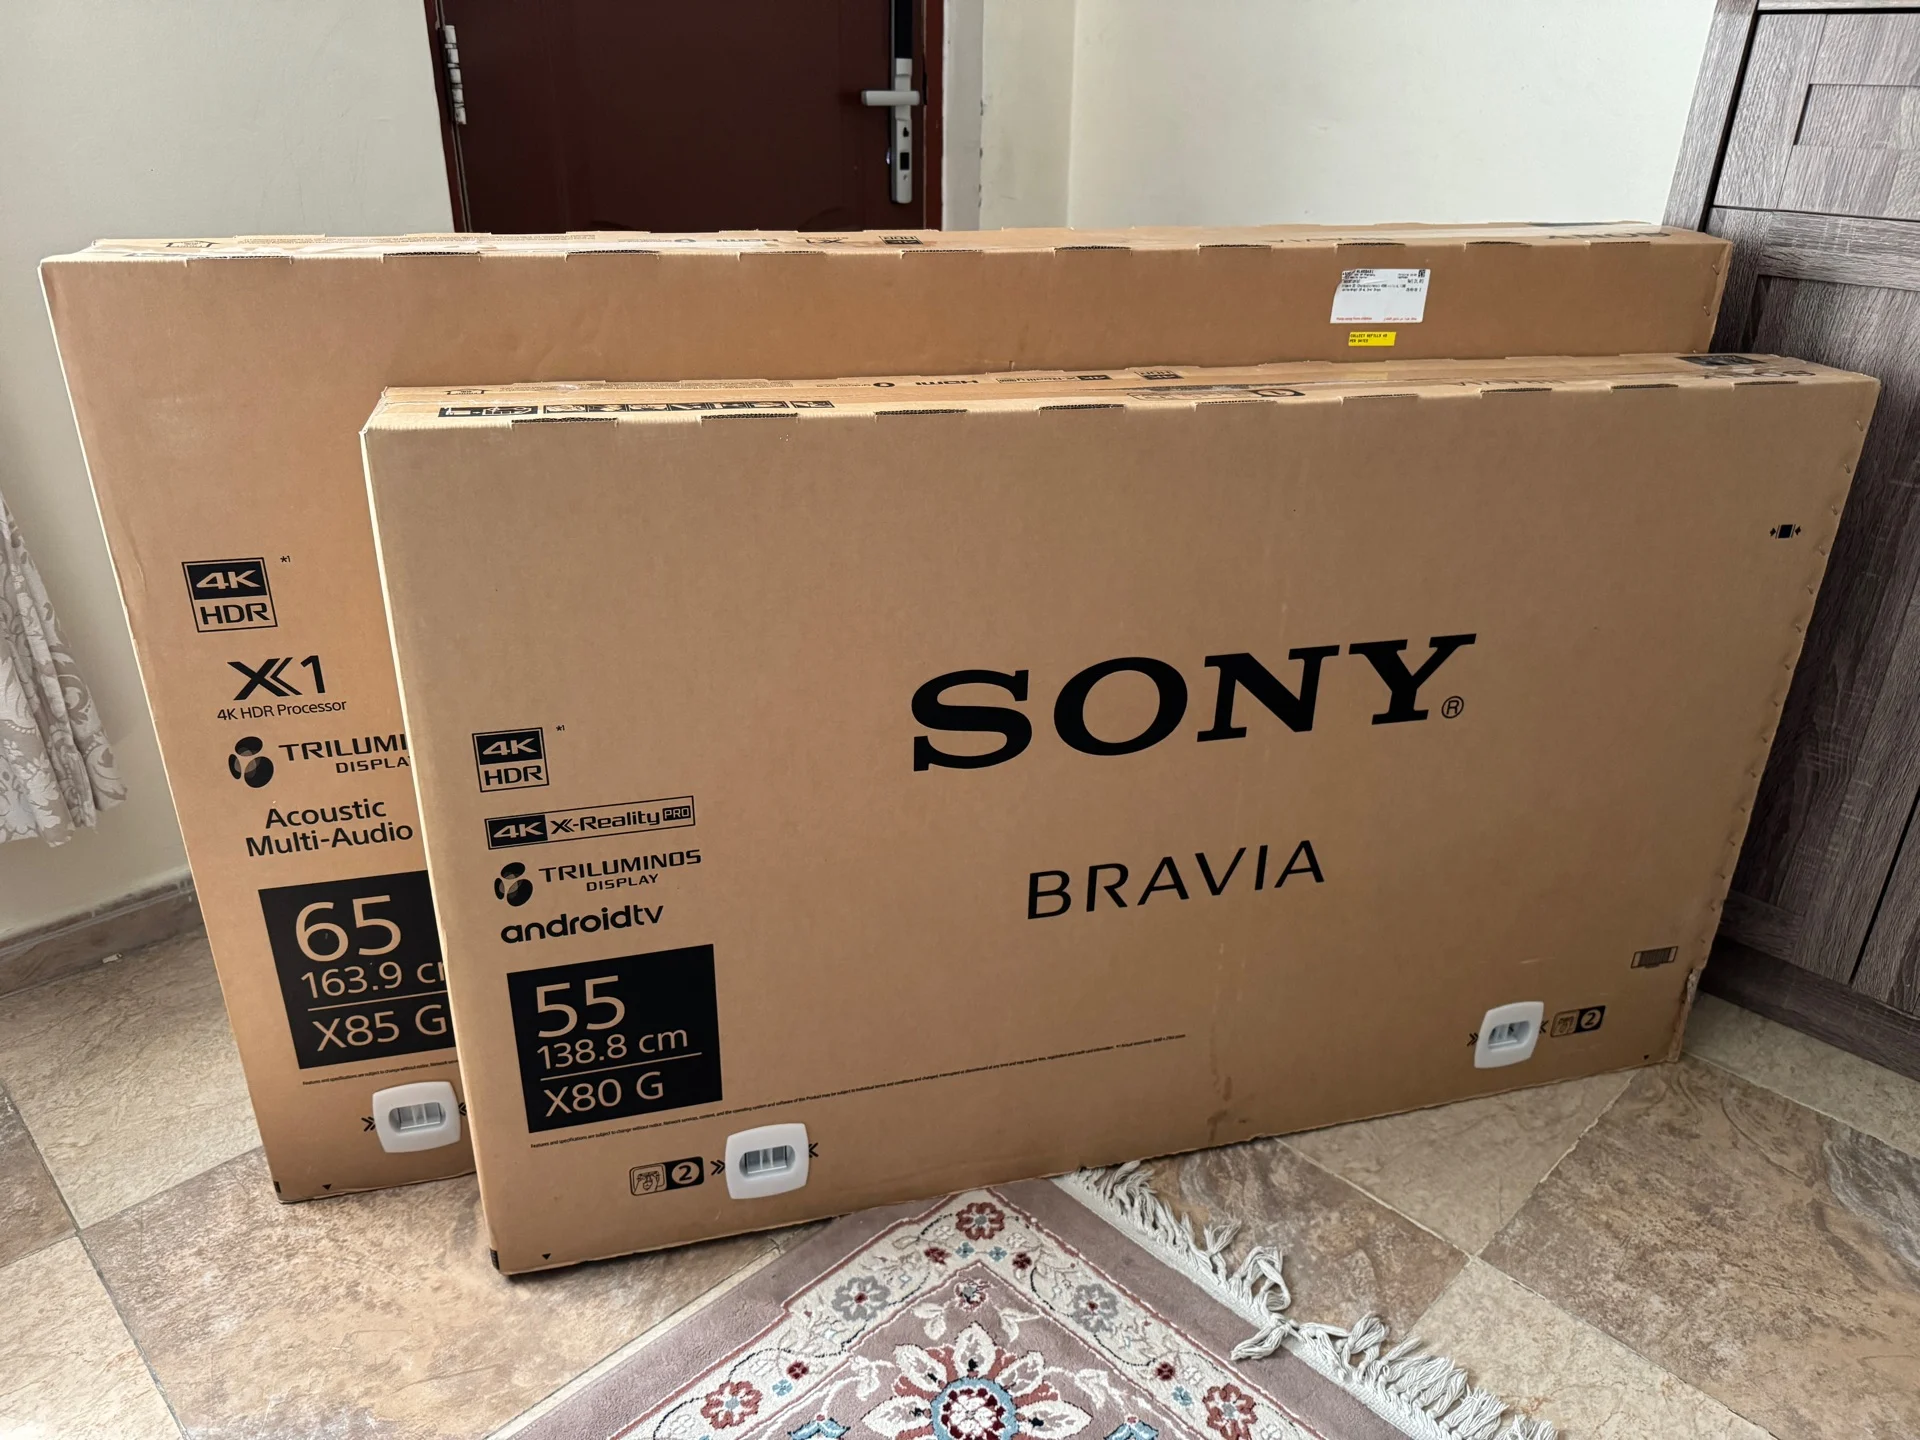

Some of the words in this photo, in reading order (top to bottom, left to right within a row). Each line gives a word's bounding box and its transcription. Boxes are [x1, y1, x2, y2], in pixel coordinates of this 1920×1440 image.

[196, 569, 261, 590] 4K
[199, 602, 271, 625] HDR
[216, 708, 238, 721] 4K
[240, 705, 275, 720] HDR
[276, 701, 347, 716] Processor
[911, 633, 1477, 772] SONY
[482, 737, 538, 756] 4K
[335, 756, 412, 774] DISPLA
[484, 765, 544, 786] HDR
[265, 798, 387, 830] Acoustic
[493, 821, 544, 839] 4K
[550, 810, 660, 835] X-Reality
[664, 806, 690, 820] PRO
[245, 822, 414, 857] Multi-Audio
[538, 849, 702, 882] TRILUMINOS
[1026, 840, 1325, 920] BRAVIA
[586, 874, 659, 892] DISPLAY
[295, 894, 402, 962] 65
[300, 961, 403, 999] 163.9
[536, 975, 626, 1038] 55
[312, 1010, 400, 1052] X85
[414, 1004, 448, 1036] G
[536, 1033, 628, 1070] 138.8
[638, 1028, 689, 1054] cm
[543, 1078, 622, 1118] X80
[636, 1070, 664, 1100] G
[678, 1164, 692, 1182] 2
